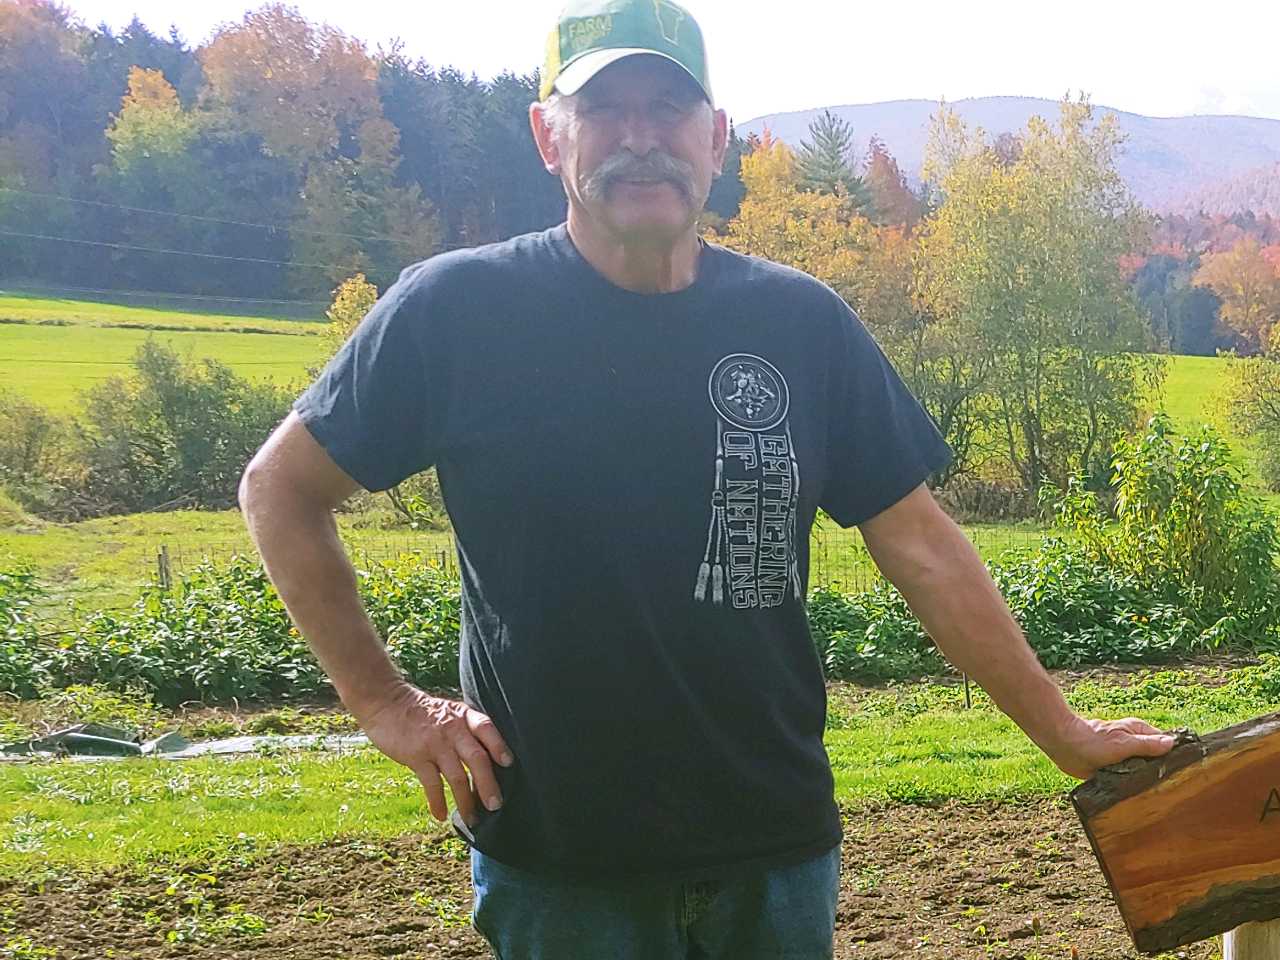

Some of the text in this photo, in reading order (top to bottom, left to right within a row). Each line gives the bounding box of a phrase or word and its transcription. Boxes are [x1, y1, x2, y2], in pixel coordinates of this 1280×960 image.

[568, 15, 612, 38] FARM
[723, 431, 758, 610] OF NATIONS
[757, 434, 792, 610] GATHERING
